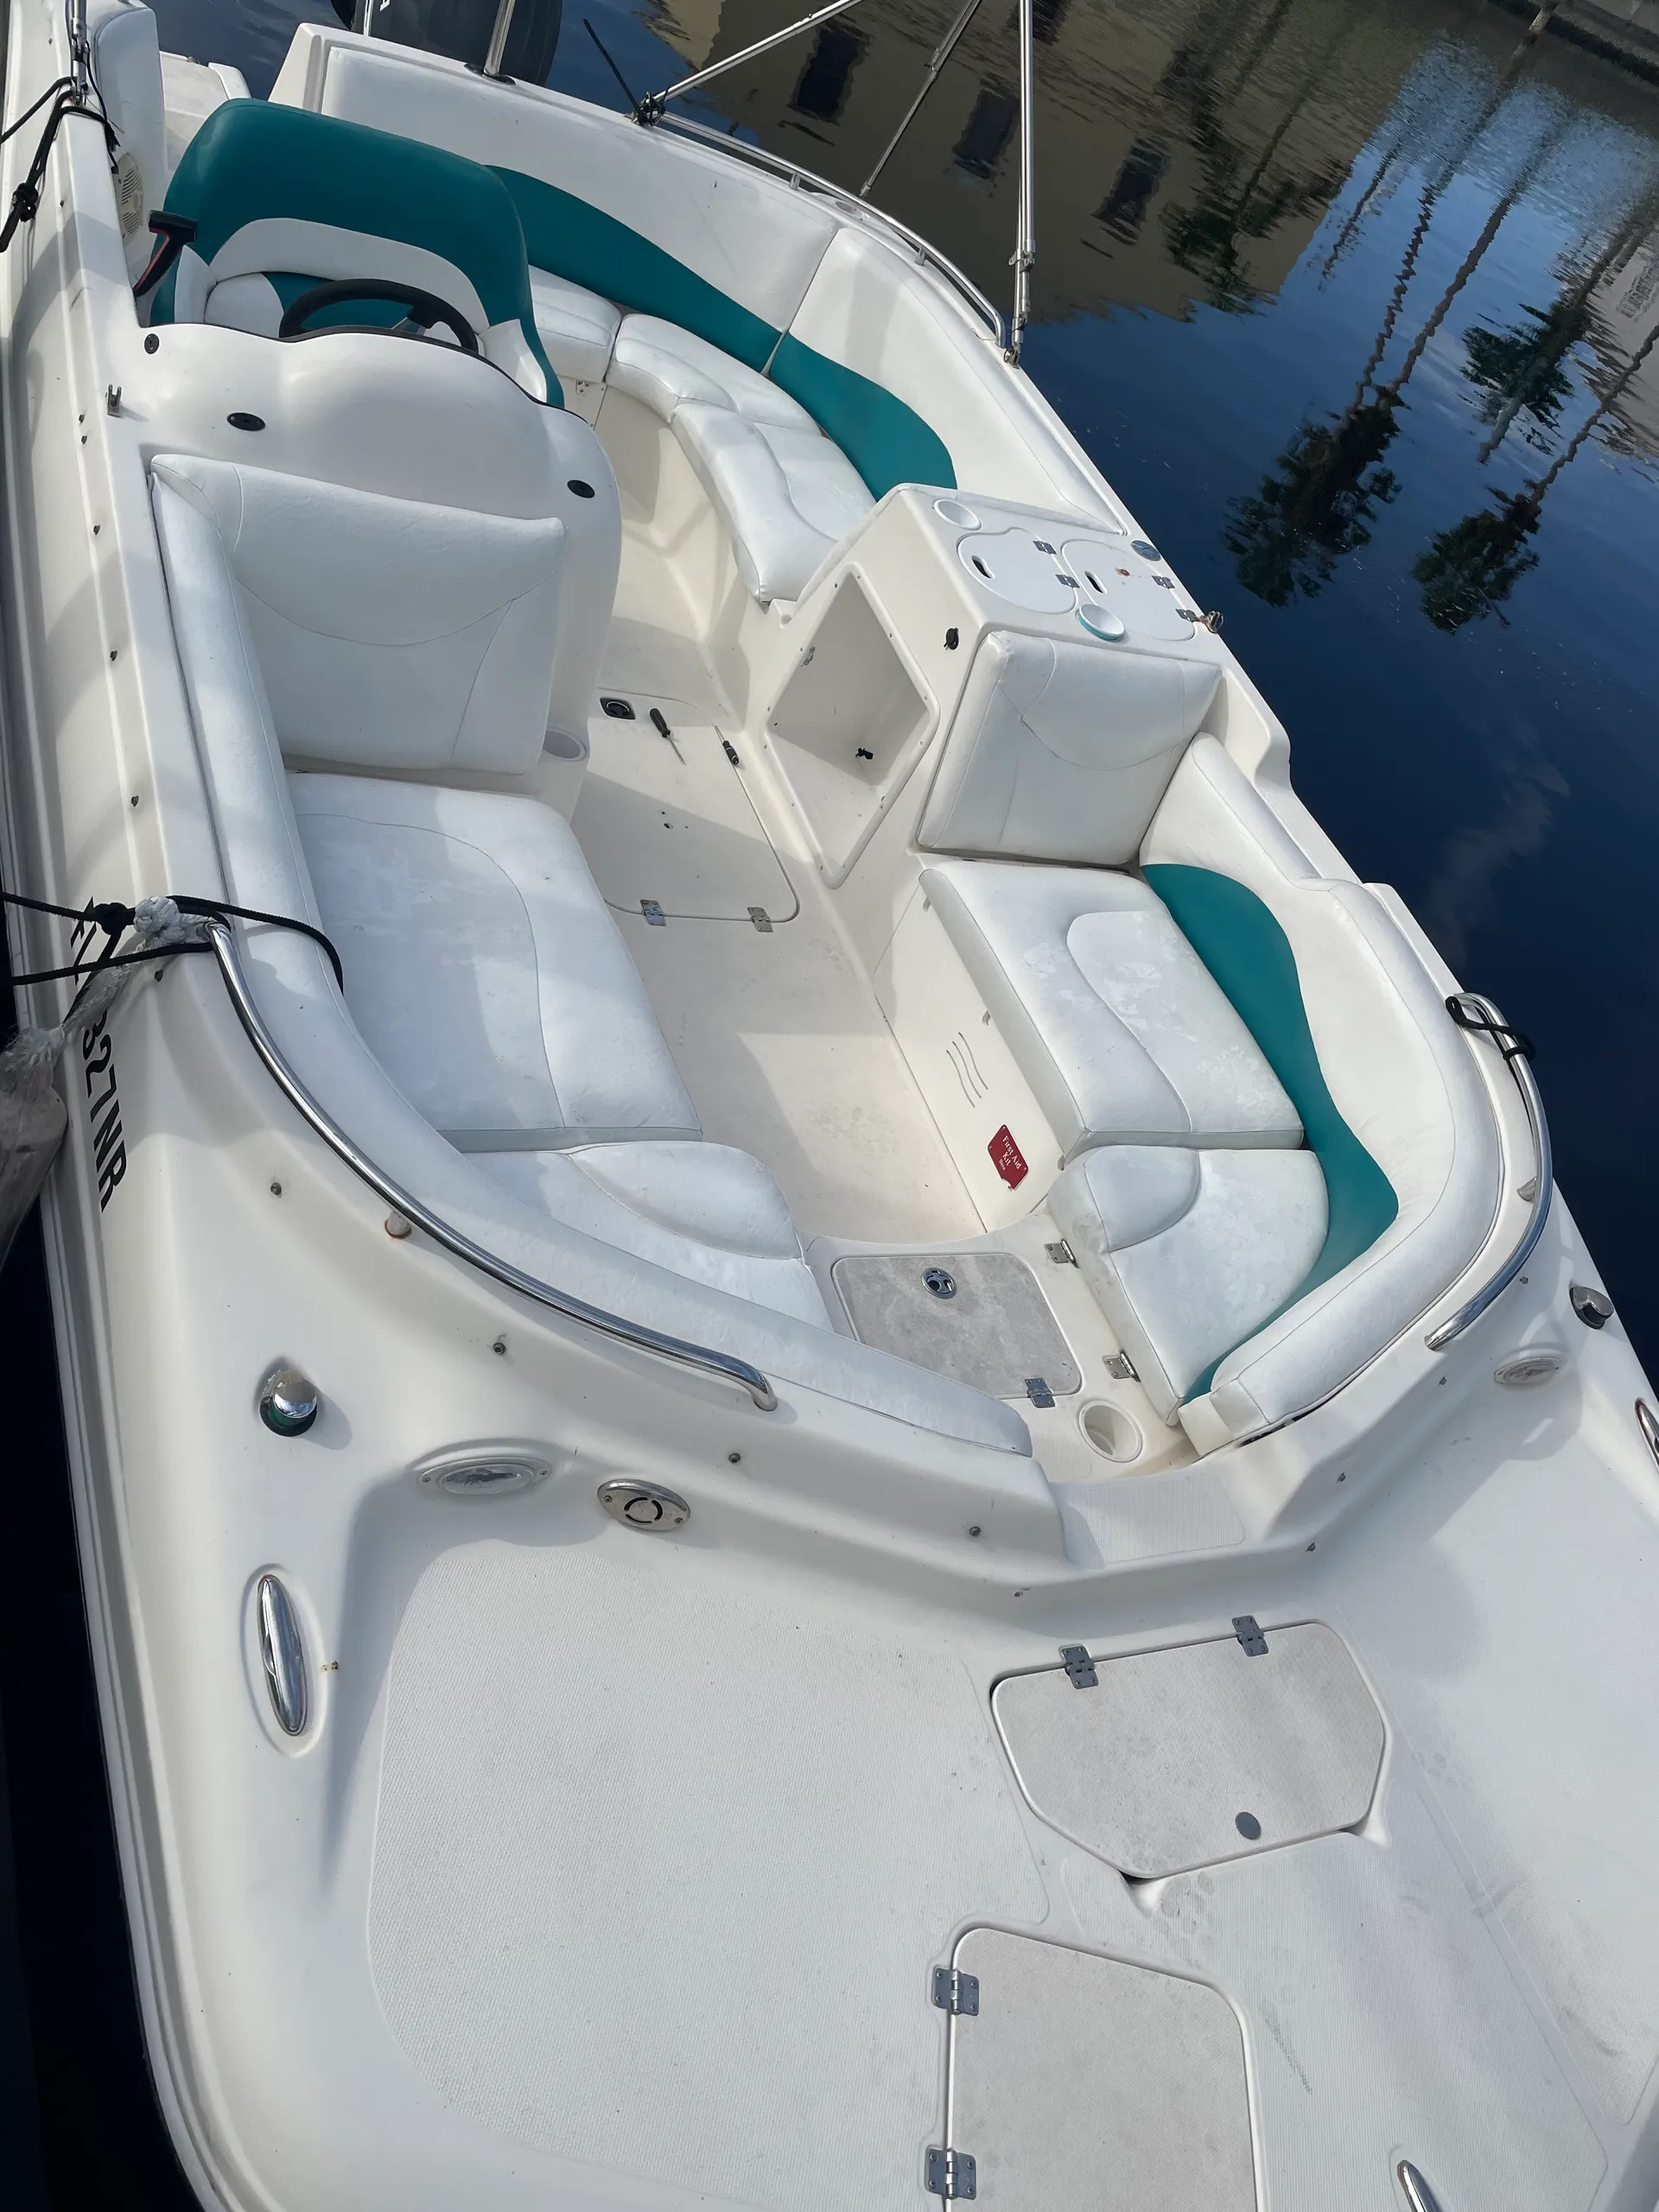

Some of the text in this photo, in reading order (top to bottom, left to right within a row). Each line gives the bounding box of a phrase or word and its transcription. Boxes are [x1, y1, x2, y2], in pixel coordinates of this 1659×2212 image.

[1002, 1135, 1023, 1170] First Aid
[1002, 1151, 1012, 1166] Kit
